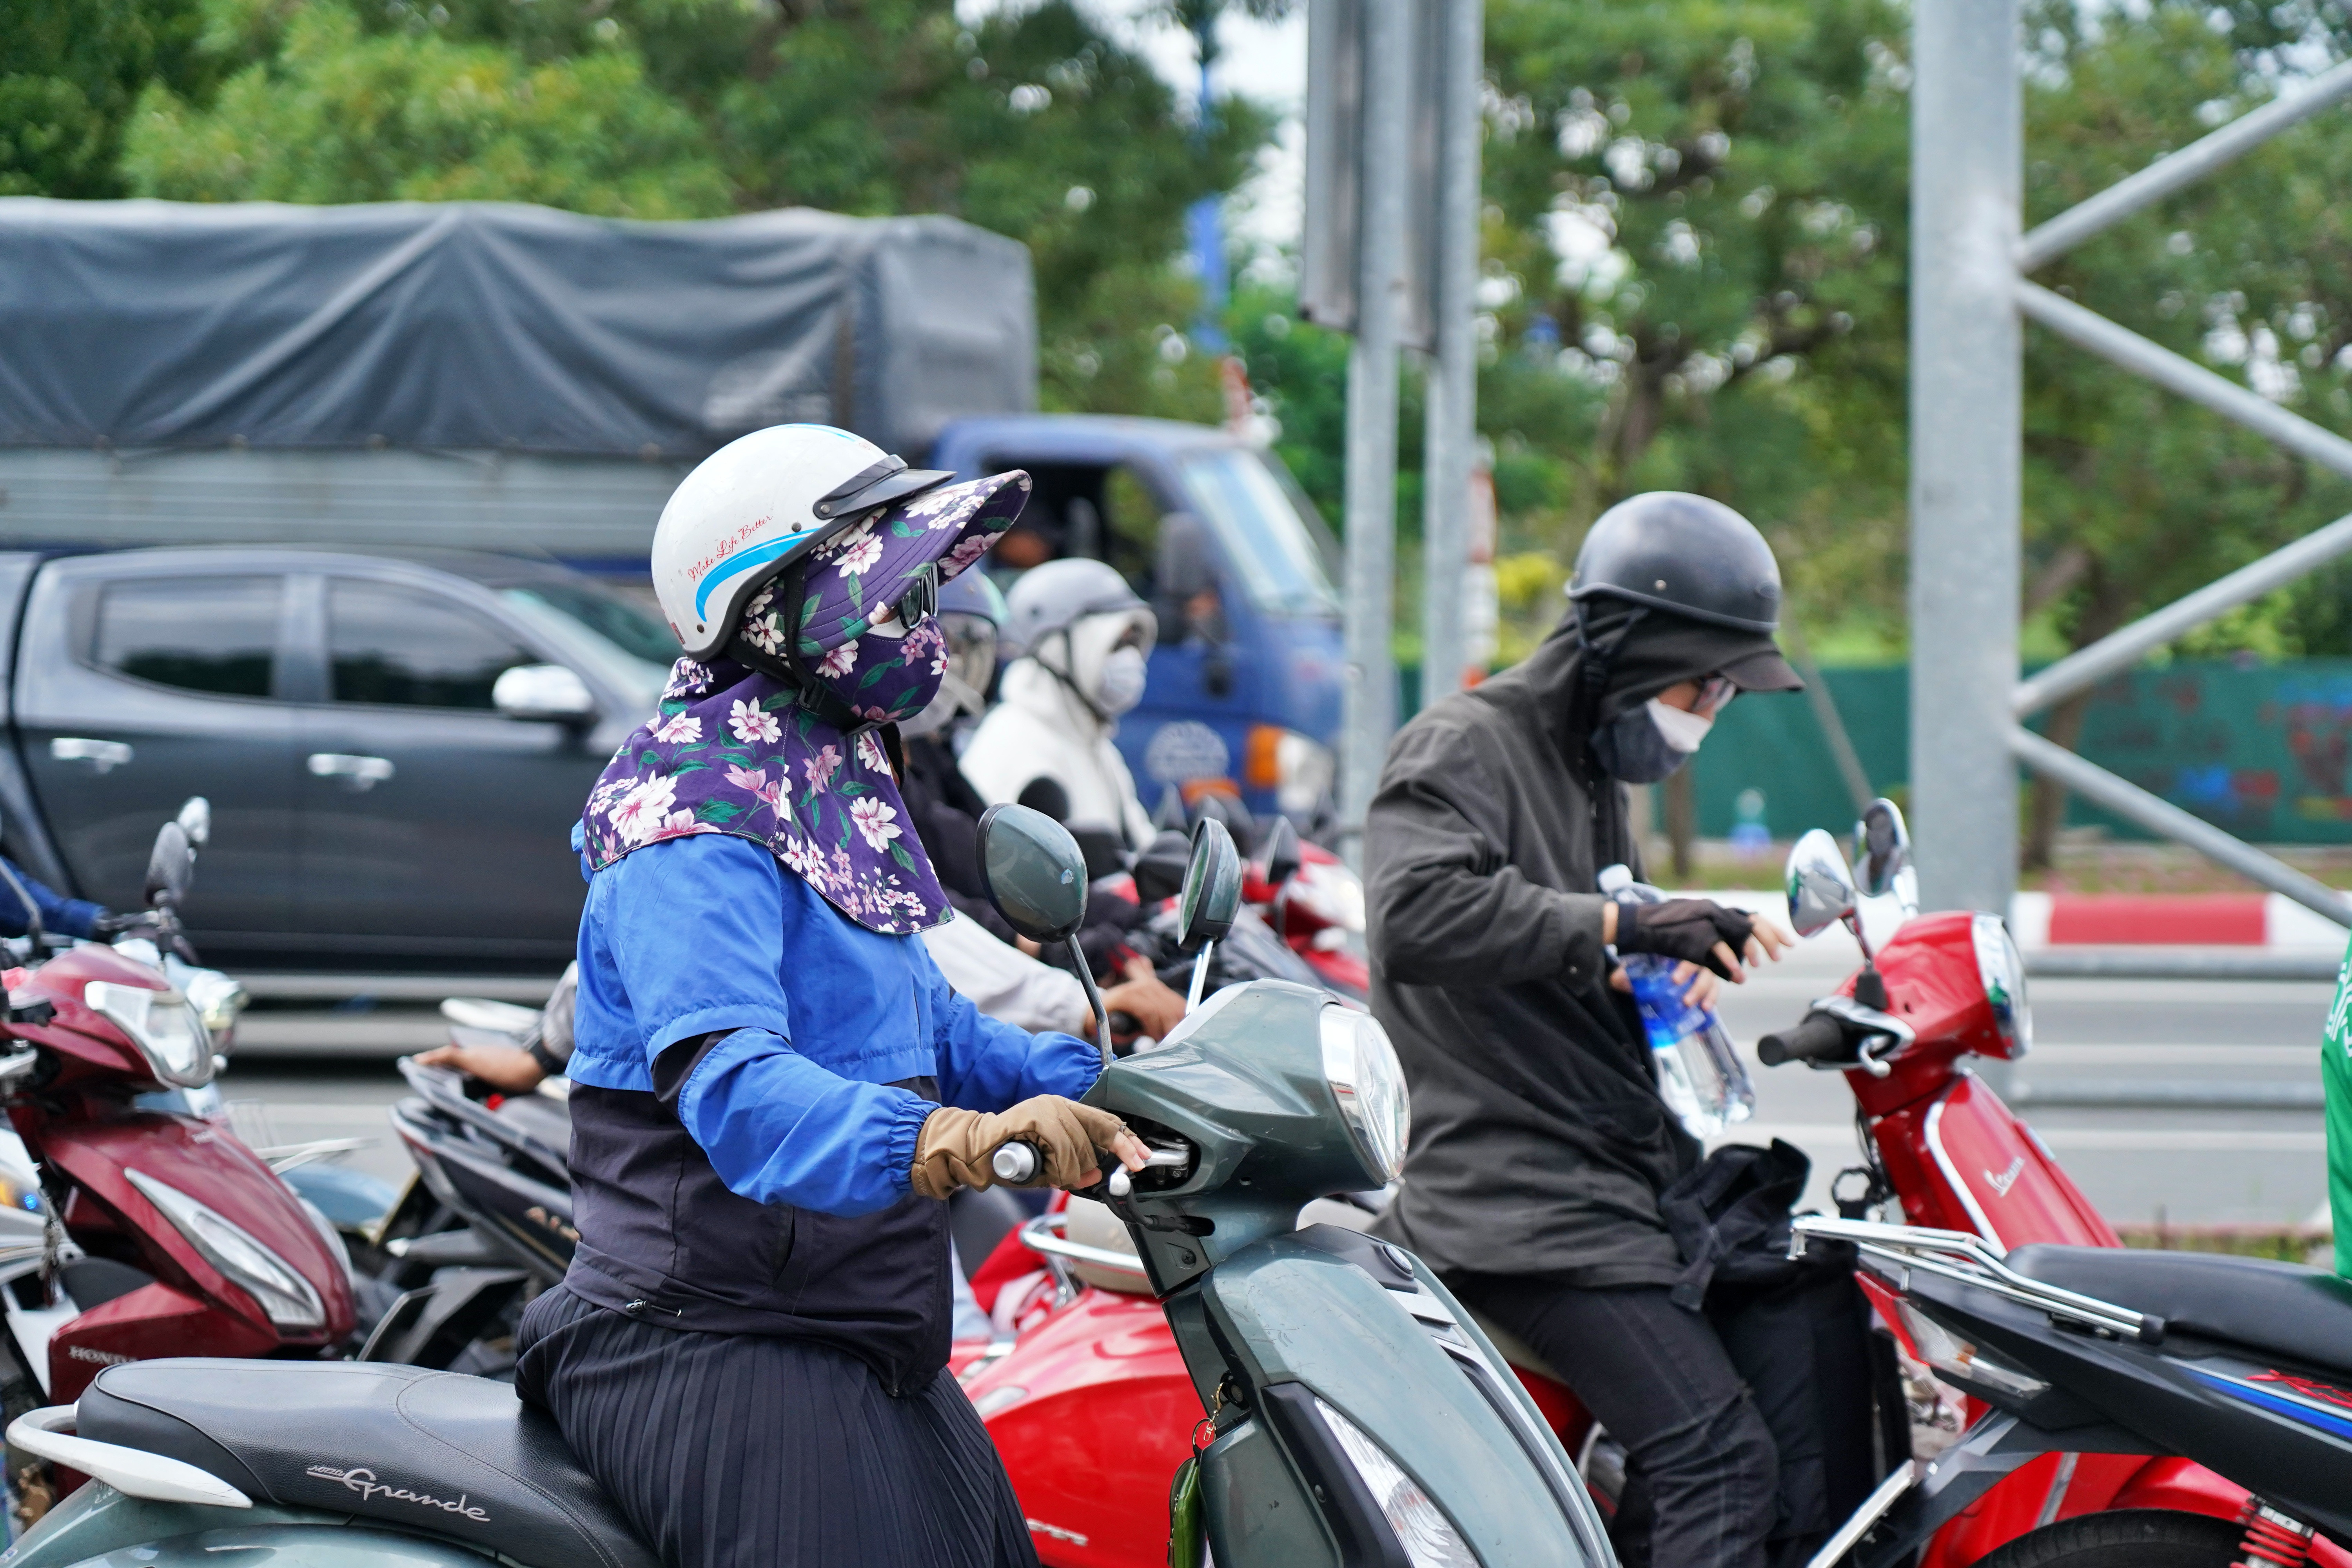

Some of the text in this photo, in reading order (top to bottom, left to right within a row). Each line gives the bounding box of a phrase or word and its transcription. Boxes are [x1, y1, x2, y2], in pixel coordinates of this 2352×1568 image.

[688, 515, 773, 582] Make Life Better
[343, 1468, 490, 1522] Grande
